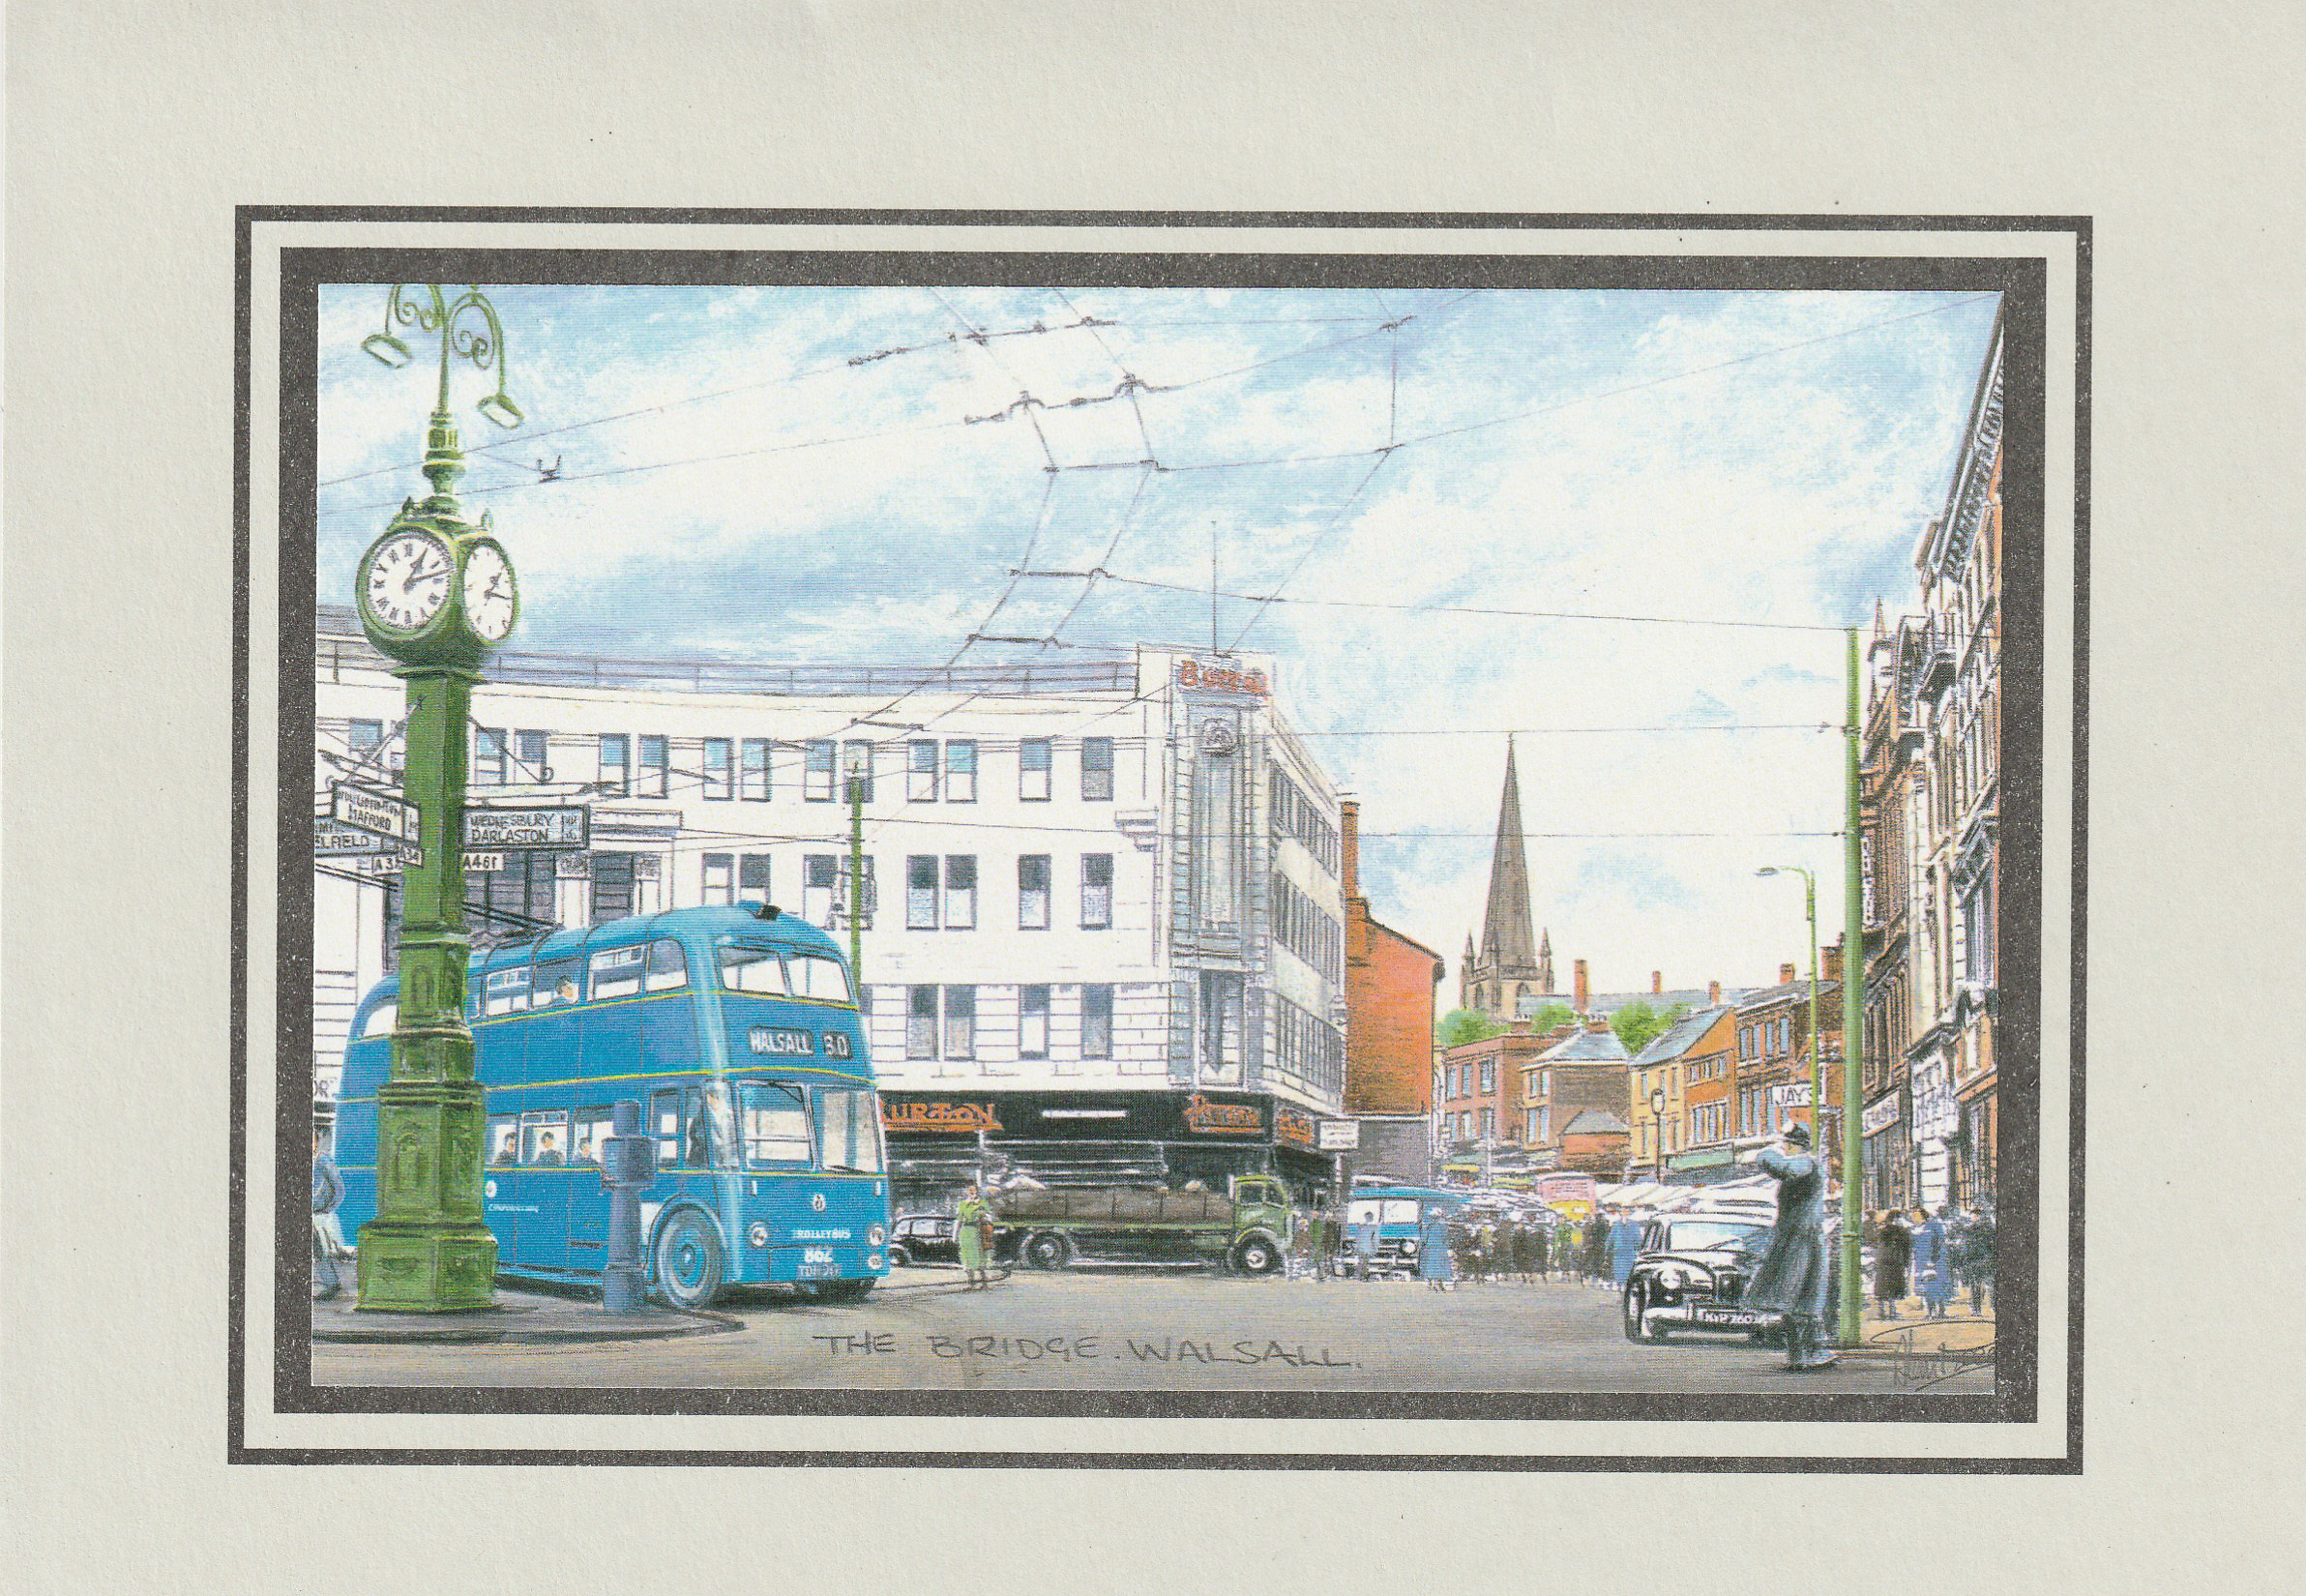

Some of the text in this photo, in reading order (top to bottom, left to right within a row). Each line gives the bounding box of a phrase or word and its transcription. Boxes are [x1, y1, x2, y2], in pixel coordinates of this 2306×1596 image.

[469, 813, 555, 829] WEDNESBURY
[470, 828, 548, 843] DARLASTON
[749, 1029, 813, 1055] WALSALL
[812, 1331, 897, 1356] THE
